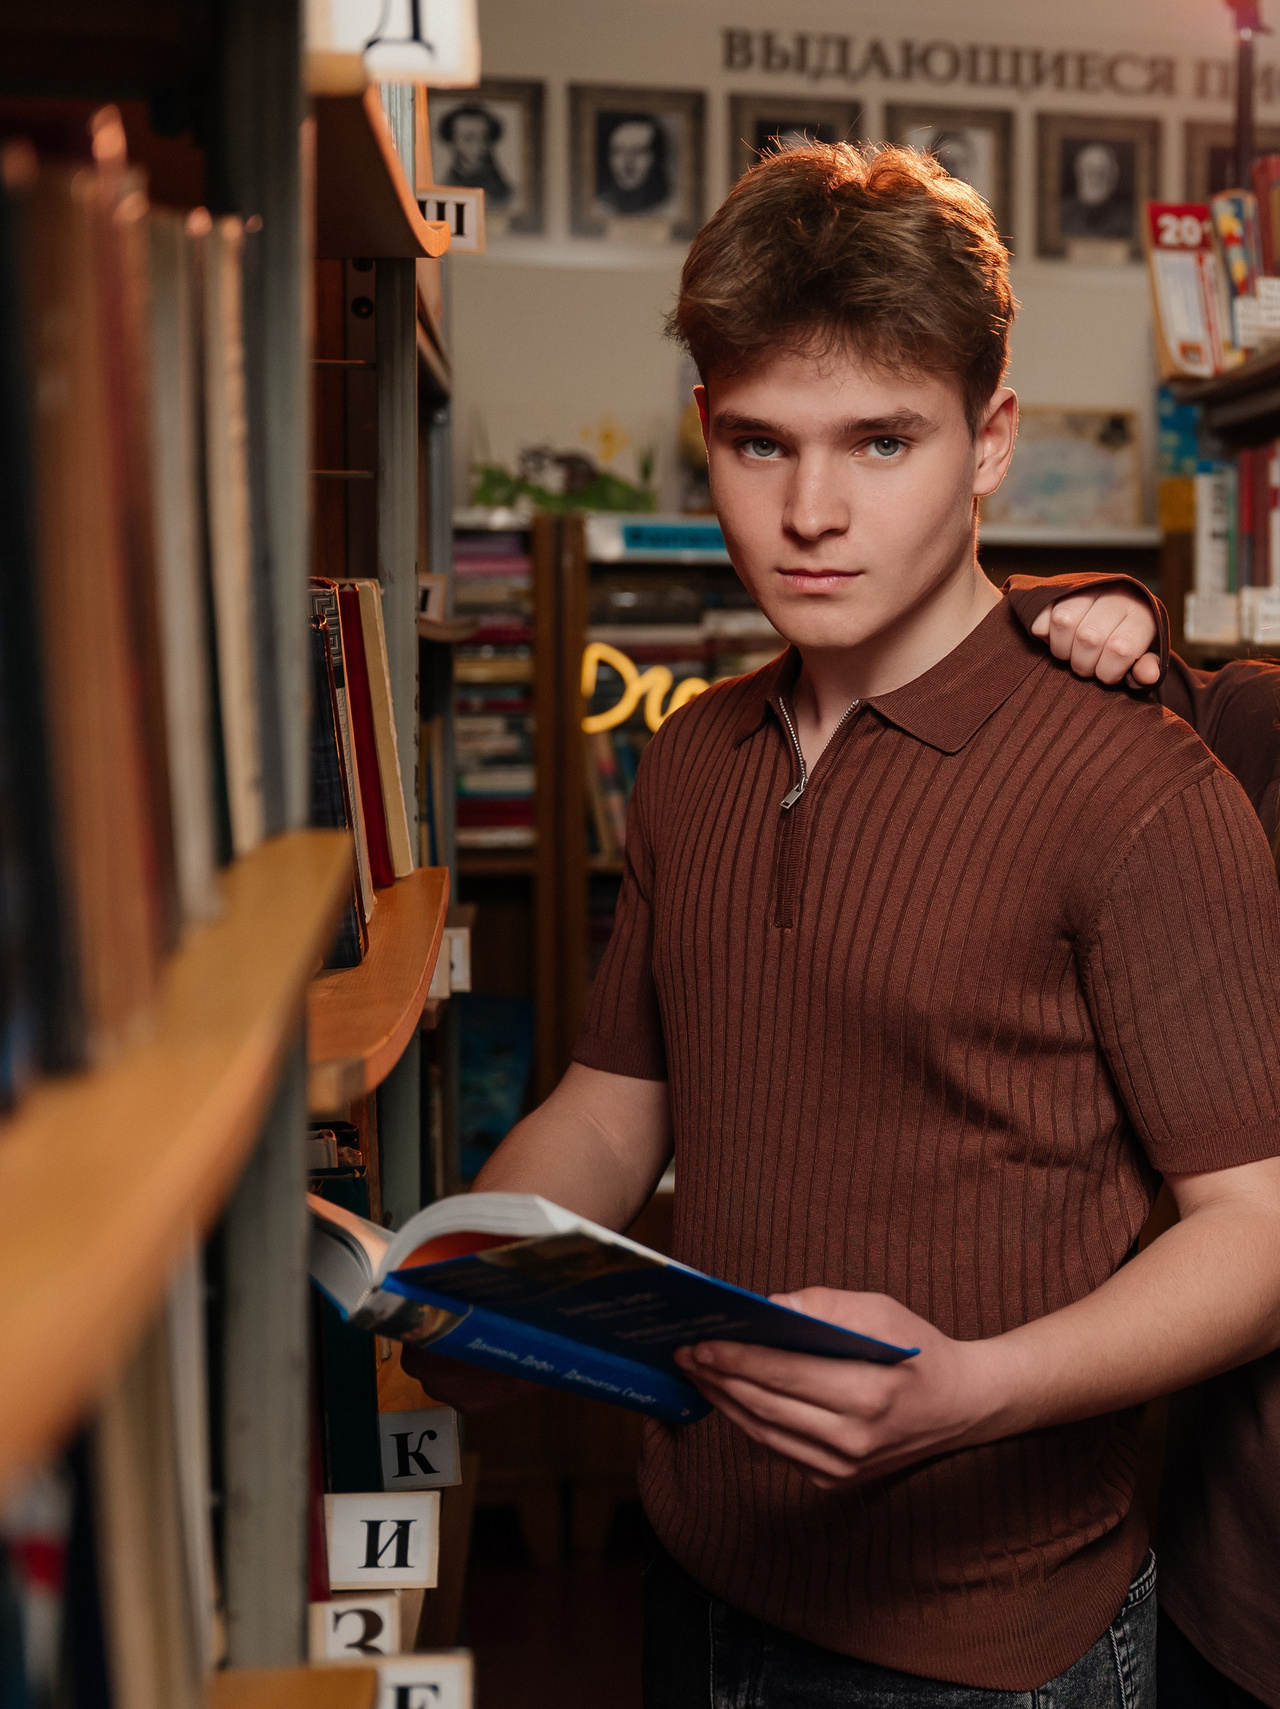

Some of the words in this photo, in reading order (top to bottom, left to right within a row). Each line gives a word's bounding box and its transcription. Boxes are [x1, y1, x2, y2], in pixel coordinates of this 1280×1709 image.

[722, 25, 1174, 96] ВЫДАЮЩИЕСЯ
[389, 1430, 441, 1478] К
[357, 1519, 418, 1569] И
[332, 1608, 385, 1656] З
